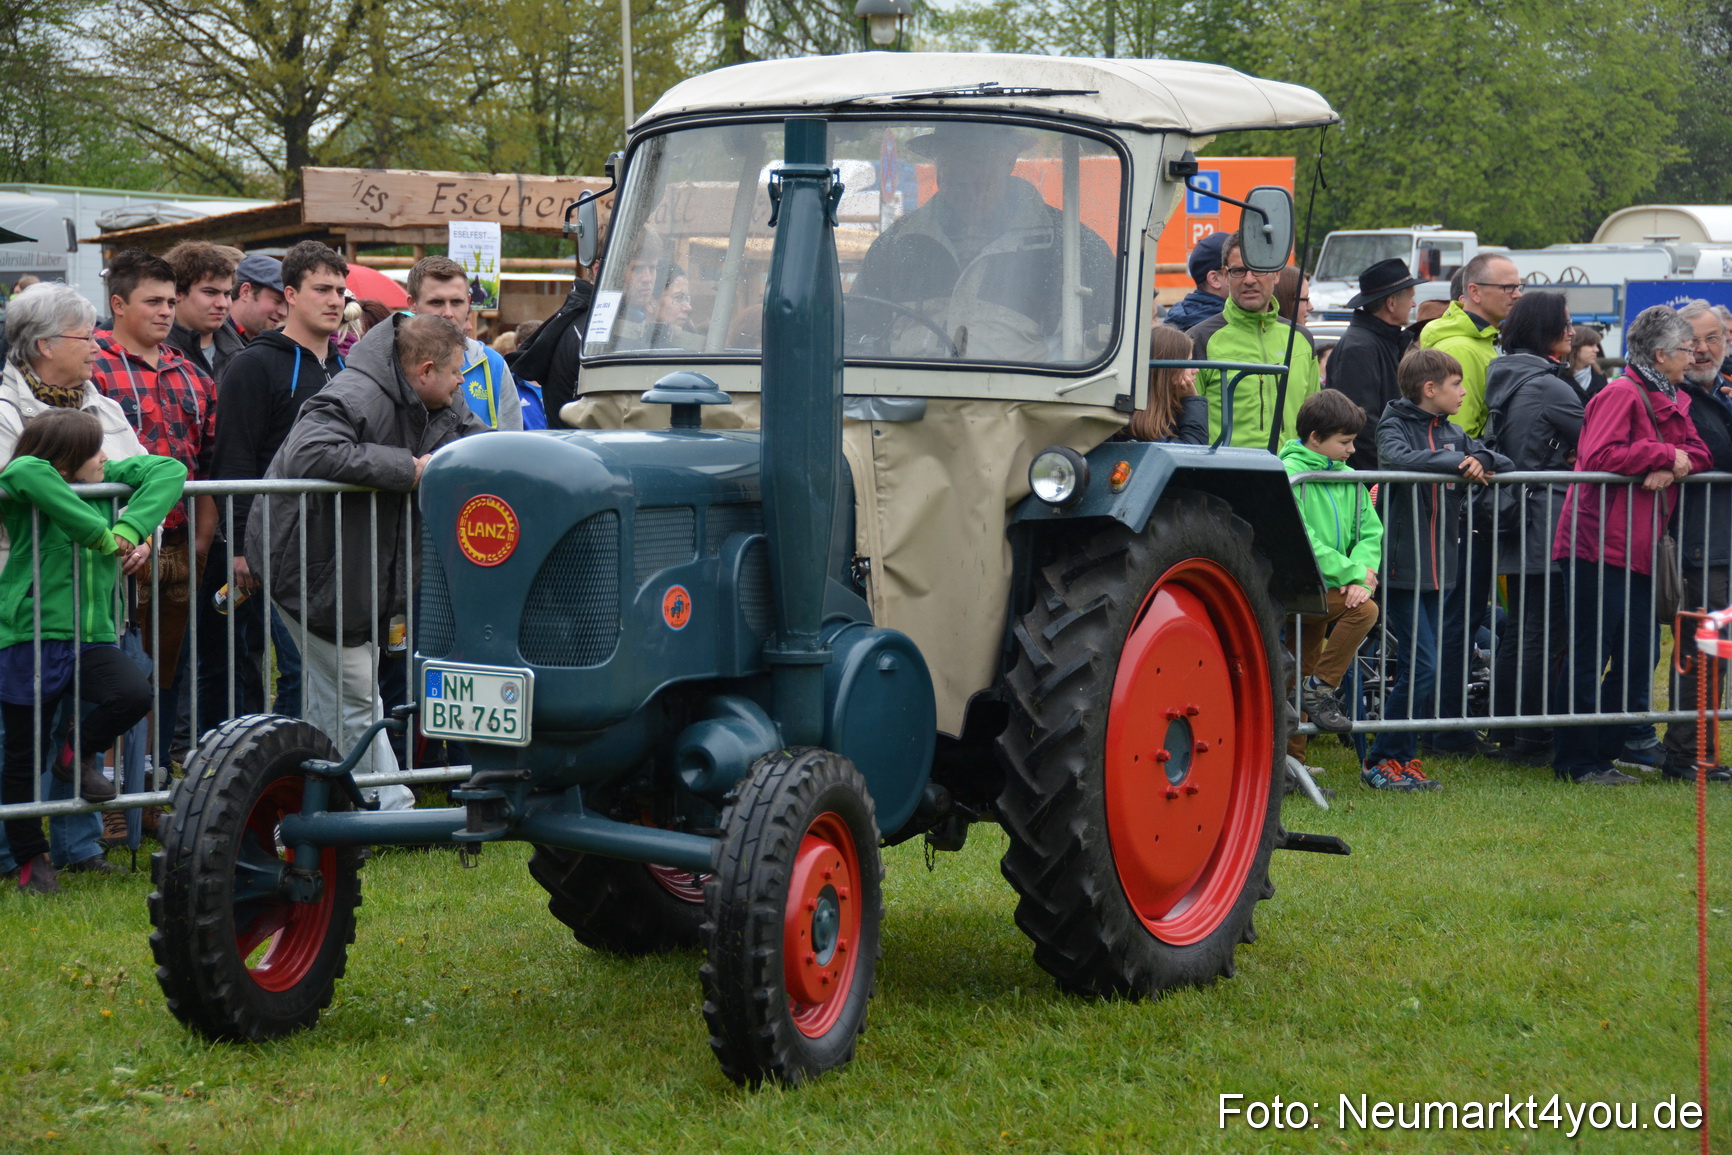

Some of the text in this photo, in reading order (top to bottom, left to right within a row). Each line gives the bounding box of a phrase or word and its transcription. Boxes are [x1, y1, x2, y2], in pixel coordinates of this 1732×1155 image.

[453, 230, 487, 240] ESELFEST
[467, 521, 506, 539] LANZ
[431, 674, 473, 702] D NM
[432, 702, 517, 734] BR 765
